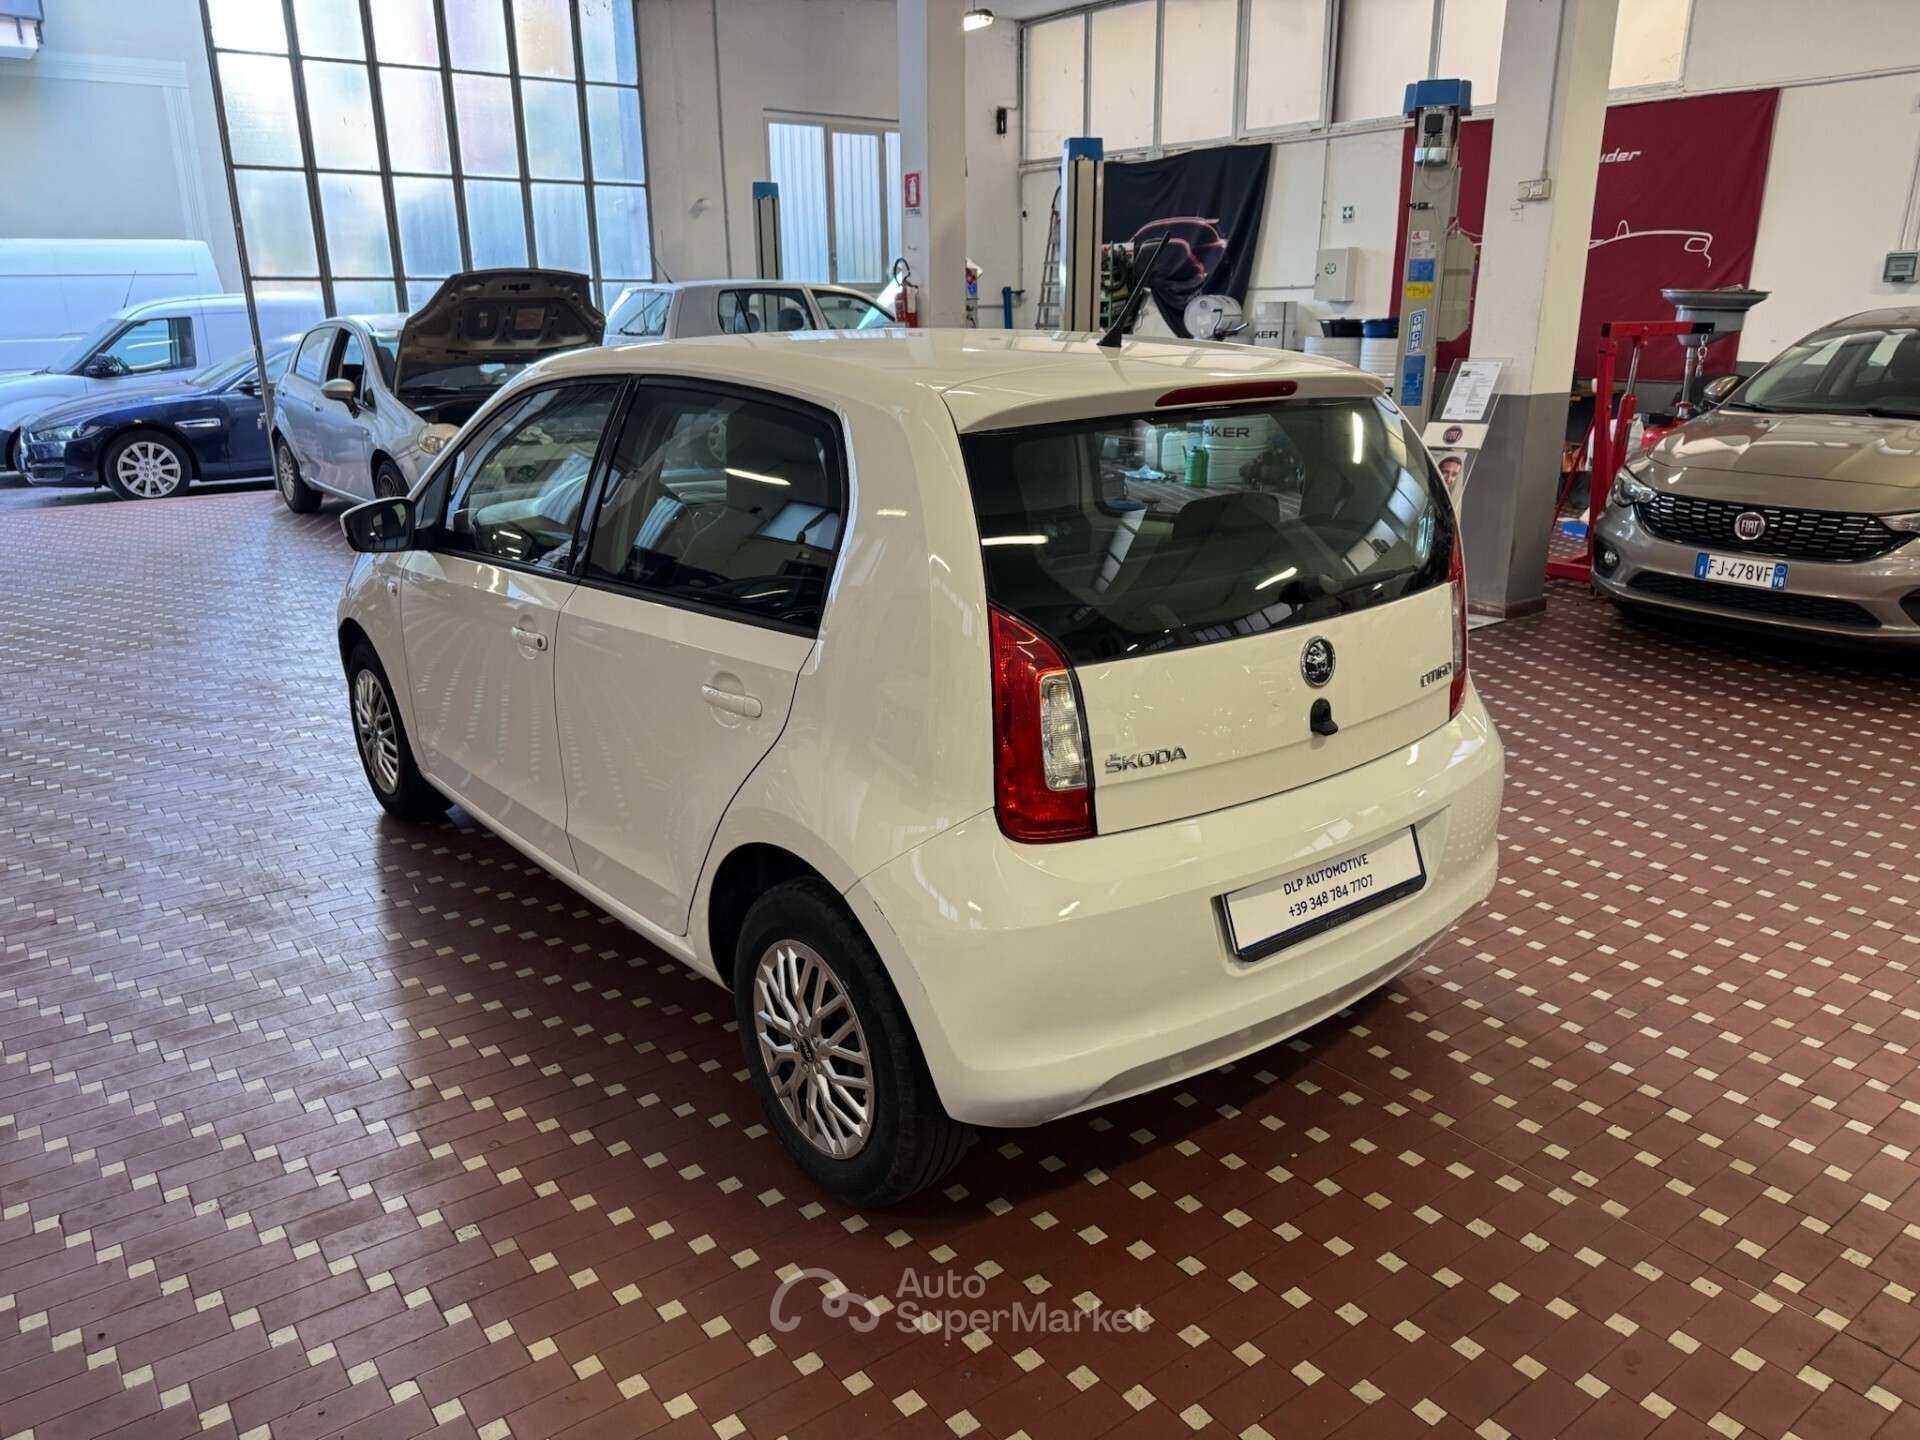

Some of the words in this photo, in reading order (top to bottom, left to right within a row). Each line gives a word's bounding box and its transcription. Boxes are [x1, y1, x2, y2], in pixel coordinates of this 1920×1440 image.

[1741, 519, 1760, 534] FIAT
[1104, 746, 1188, 775] ŠKODA
[1283, 878, 1303, 896] DLP
[1306, 853, 1369, 887] AUTOMOTIVE
[1288, 900, 1308, 917] +39
[1309, 891, 1329, 911] 348
[1329, 885, 1349, 901] 784
[1350, 874, 1374, 894] 7707
